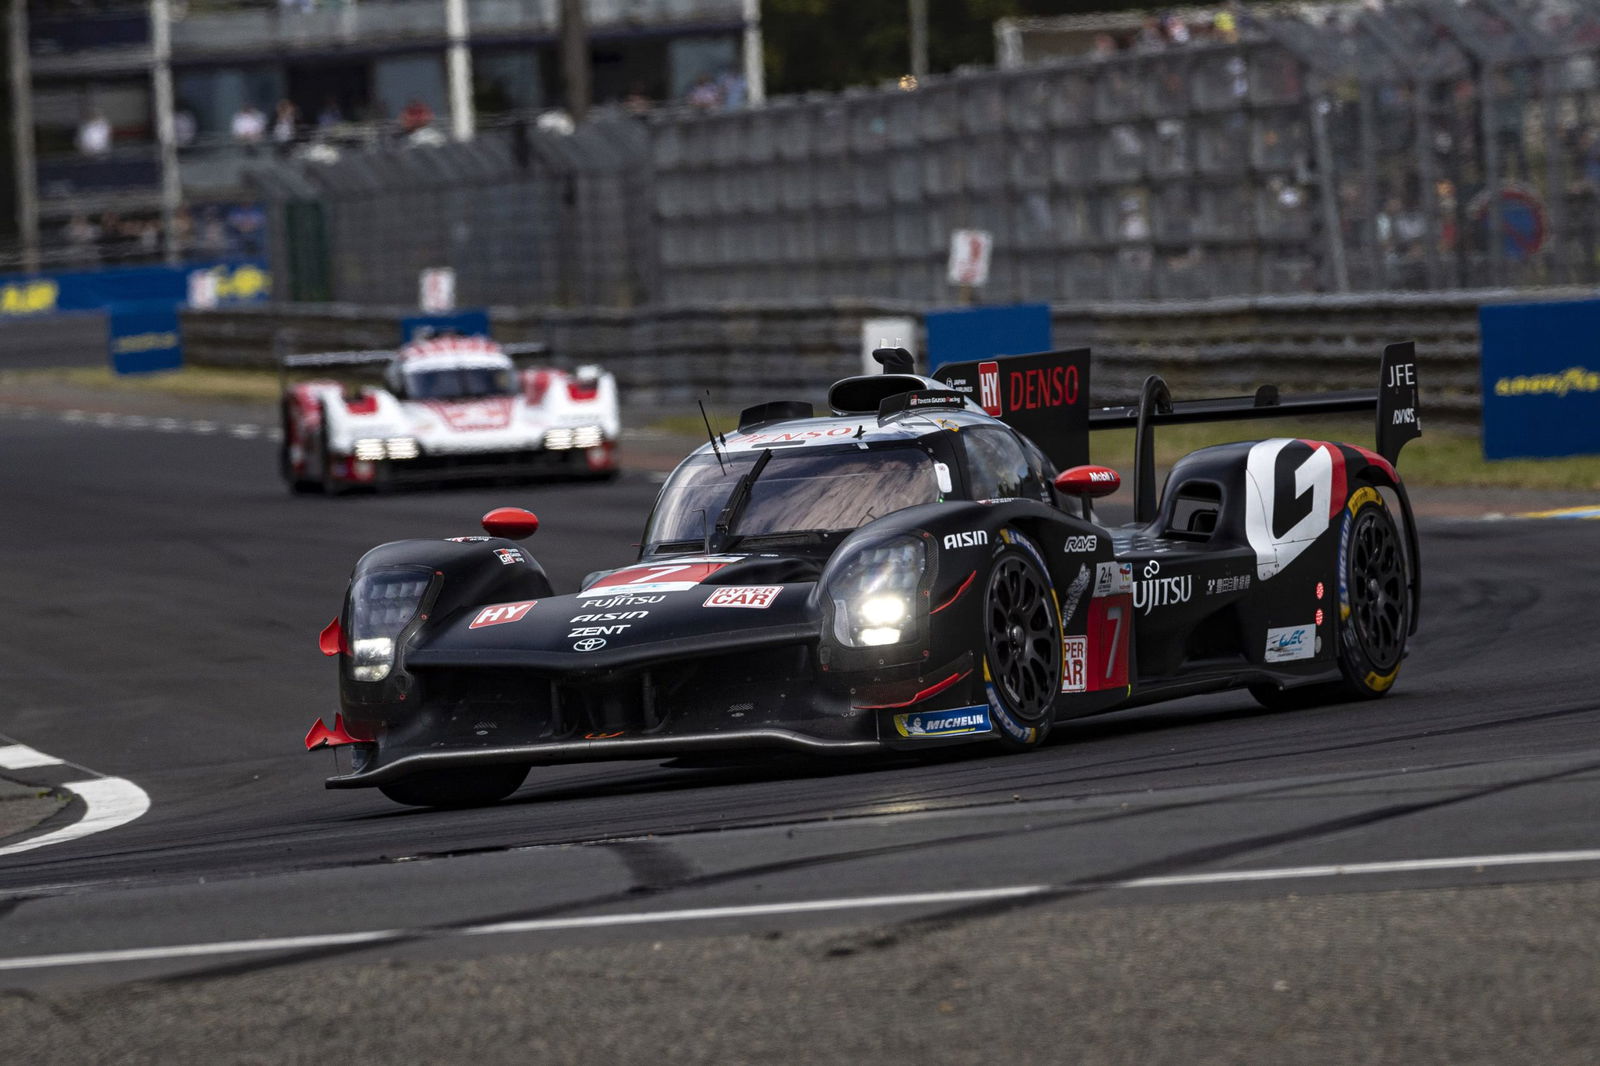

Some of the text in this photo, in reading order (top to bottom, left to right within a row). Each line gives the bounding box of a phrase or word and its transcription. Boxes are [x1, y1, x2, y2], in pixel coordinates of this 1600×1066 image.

[1387, 363, 1415, 388] JFE
[980, 372, 999, 408] HY
[1009, 364, 1080, 412] DENSO
[729, 426, 852, 444] DENSO
[1088, 471, 1110, 483] Mobil
[943, 530, 989, 550] AISIN
[1064, 535, 1098, 553] RAYS
[628, 565, 692, 584] 7
[711, 594, 770, 606] CAR
[718, 587, 775, 595] HYPER
[1132, 574, 1193, 616] UJITSU
[580, 594, 667, 609] FUJITSU
[476, 603, 528, 624] HY
[570, 610, 650, 623] AISIN
[567, 624, 631, 638] ZENT
[1063, 641, 1084, 659] PER
[1105, 607, 1122, 679] 7
[1062, 658, 1084, 686] AR
[926, 714, 984, 731] MICHELIN
